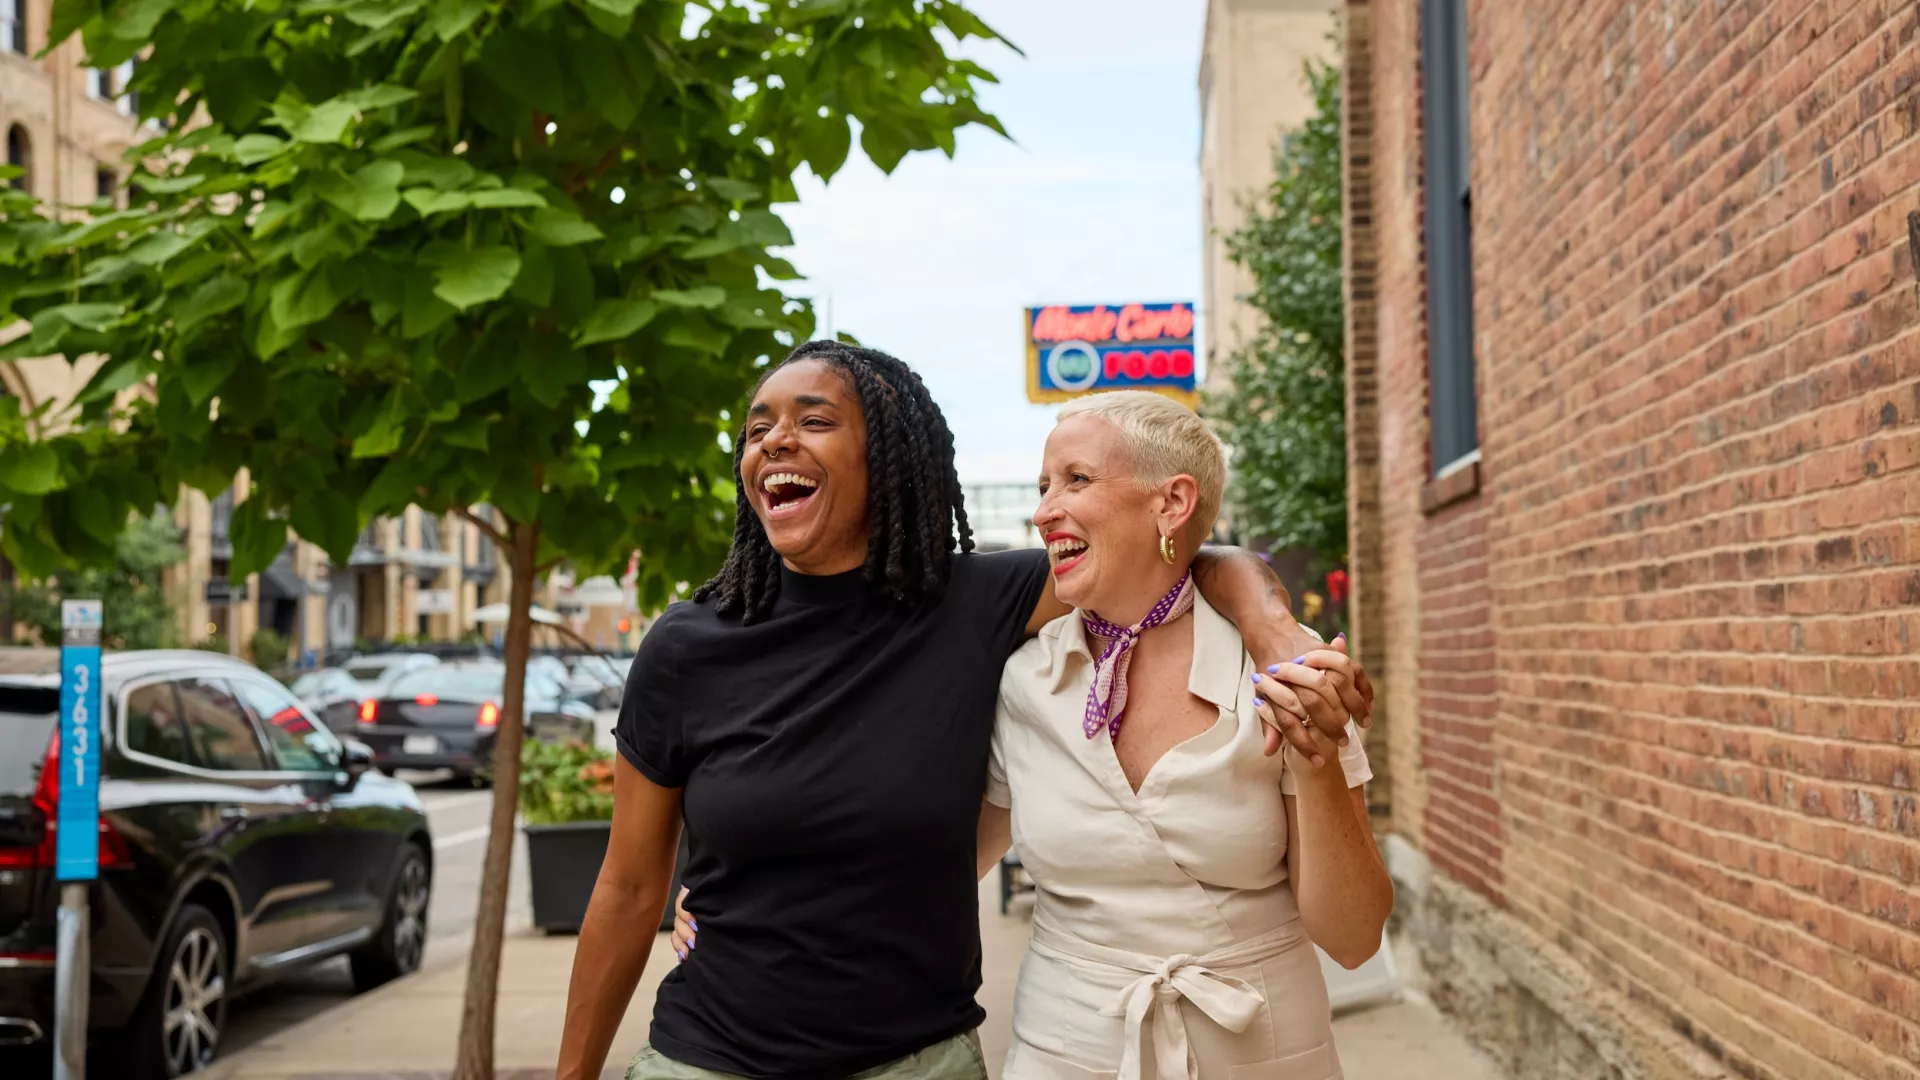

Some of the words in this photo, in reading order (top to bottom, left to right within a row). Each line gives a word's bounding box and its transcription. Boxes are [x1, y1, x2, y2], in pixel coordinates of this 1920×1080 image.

[1116, 302, 1194, 342] Carlo
[1103, 349, 1195, 380] FOOD
[72, 664, 89, 787] 3631
